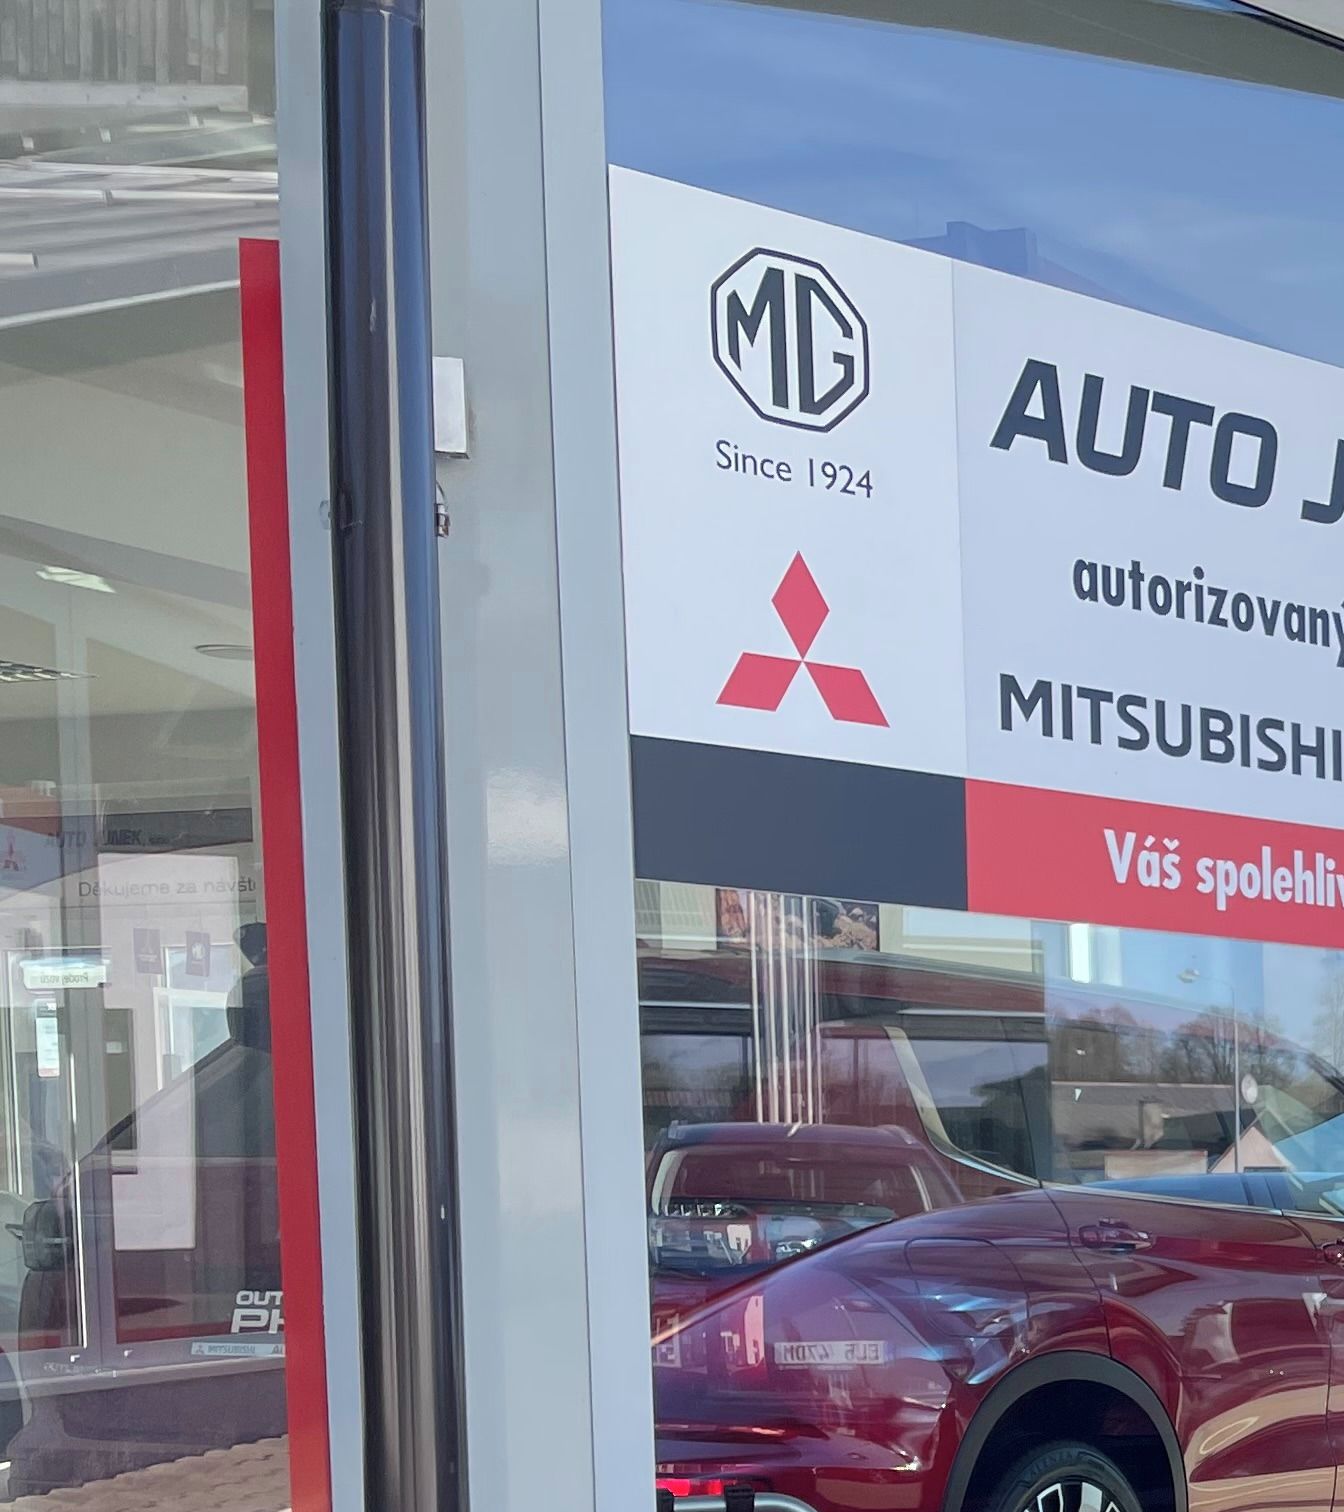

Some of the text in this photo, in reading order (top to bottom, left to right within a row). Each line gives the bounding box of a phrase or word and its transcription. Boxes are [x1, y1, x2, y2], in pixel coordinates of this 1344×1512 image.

[726, 266, 855, 416] MG
[715, 439, 874, 499] Since 1924
[988, 357, 1279, 509] AUTO
[998, 672, 1344, 783] MITSUBISHI
[78, 878, 170, 898] Děkujeme
[176, 882, 197, 896] za
[1103, 827, 1182, 890] Váš
